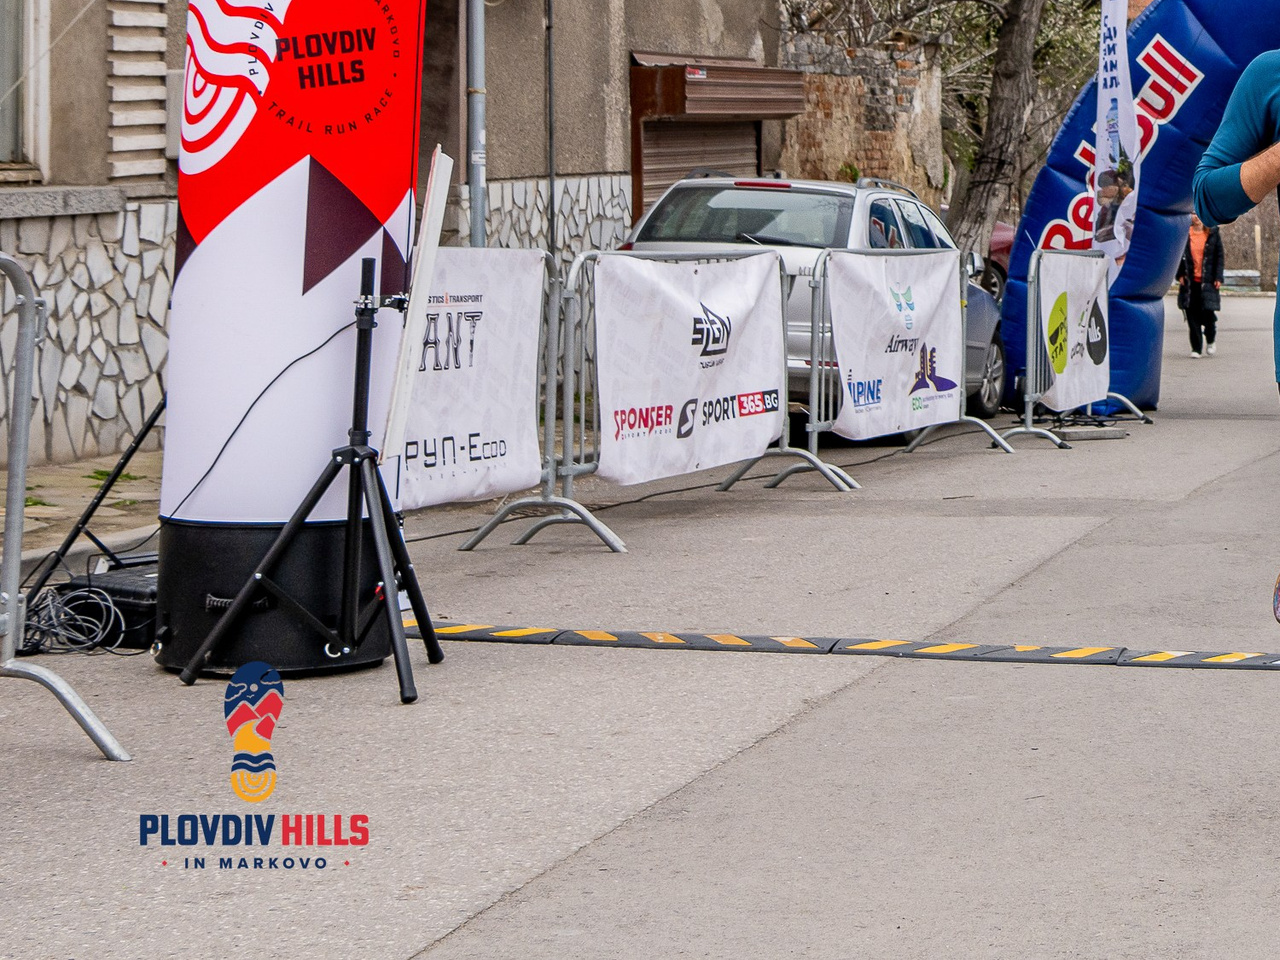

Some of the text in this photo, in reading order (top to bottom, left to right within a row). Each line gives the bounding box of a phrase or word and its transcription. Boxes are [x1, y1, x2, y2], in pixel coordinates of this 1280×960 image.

[248, 3, 274, 76] PLOVDIV
[275, 27, 376, 62] PLOVDIV
[298, 59, 365, 89] HILLS
[268, 88, 393, 135] TRAIL RUN RACE
[449, 294, 483, 303] TRANSPORT
[885, 335, 920, 356] Airway
[614, 405, 673, 441] SPONSER
